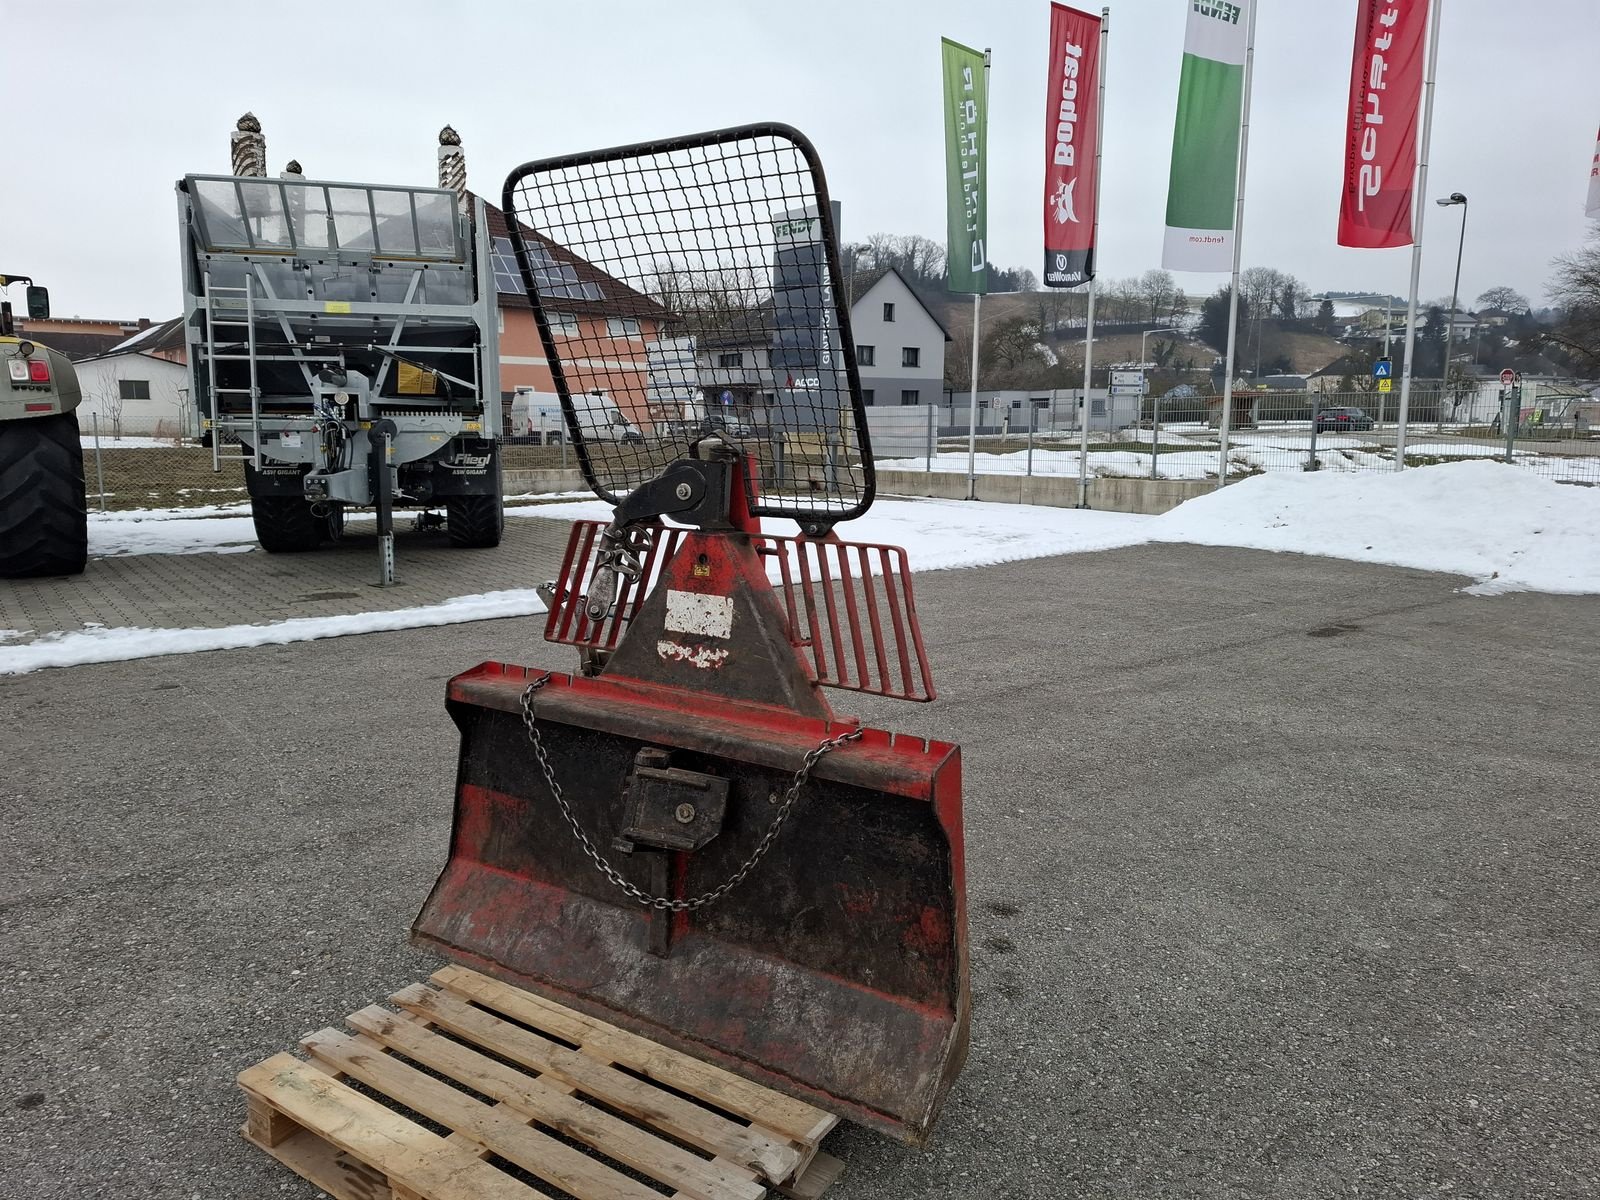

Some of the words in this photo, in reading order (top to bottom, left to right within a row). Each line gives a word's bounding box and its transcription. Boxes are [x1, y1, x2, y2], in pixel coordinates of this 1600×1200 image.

[776, 219, 816, 238] FENDT
[794, 378, 820, 387] AGCO
[454, 453, 492, 467] Fliegl
